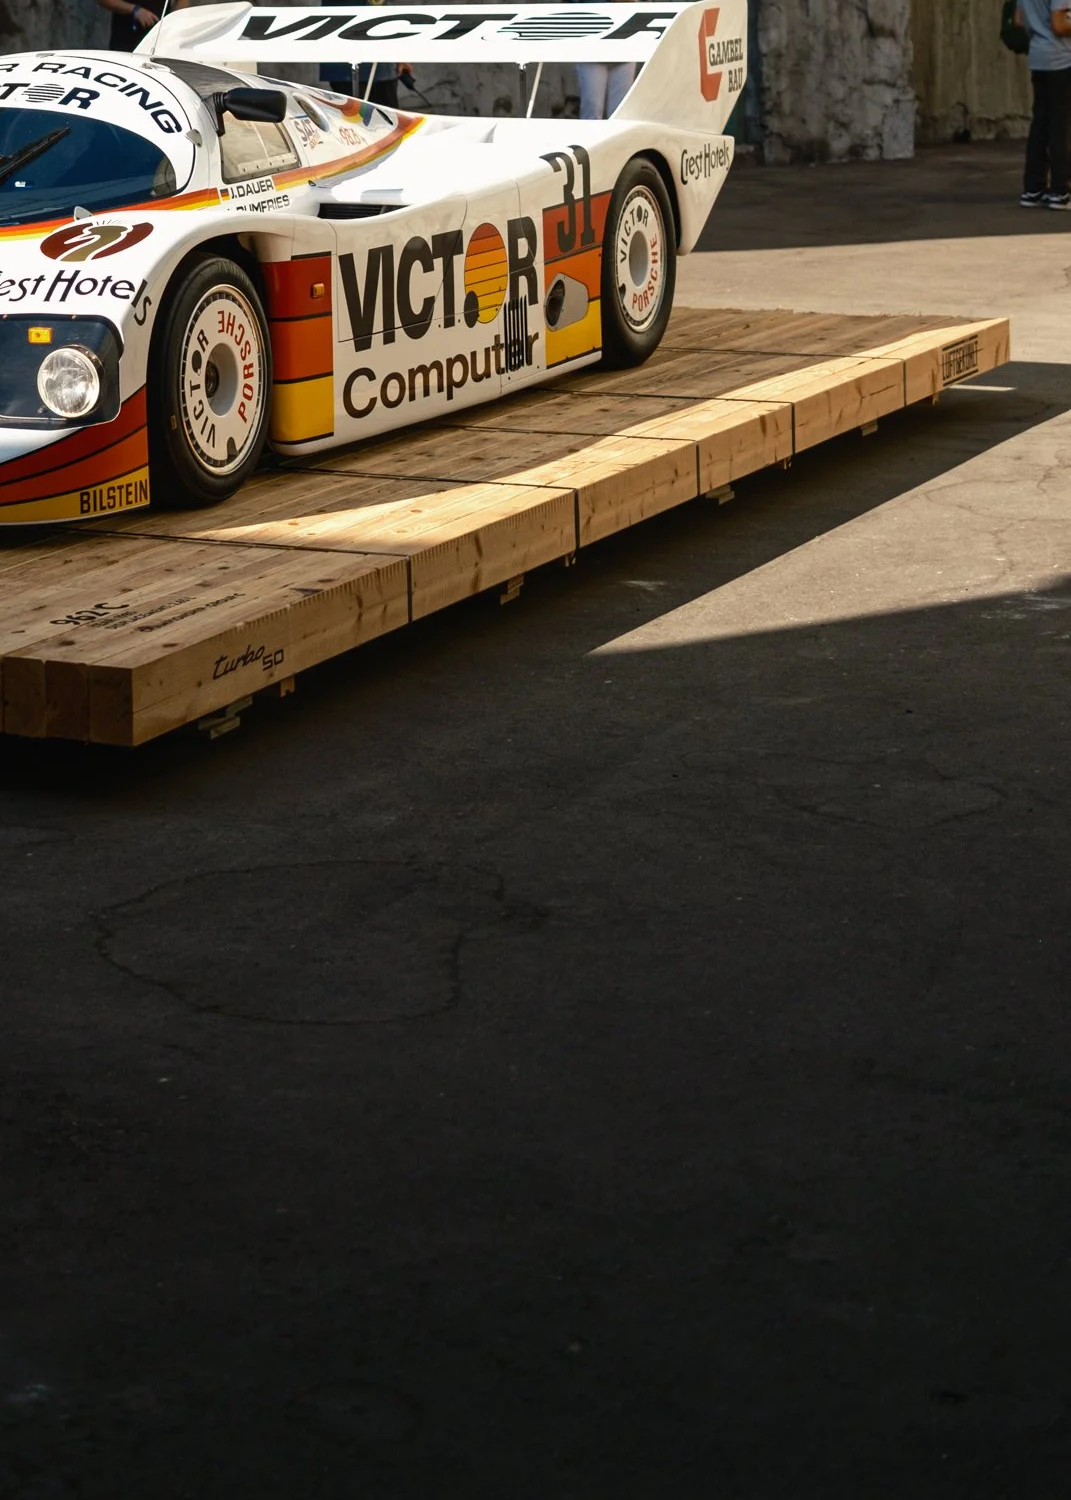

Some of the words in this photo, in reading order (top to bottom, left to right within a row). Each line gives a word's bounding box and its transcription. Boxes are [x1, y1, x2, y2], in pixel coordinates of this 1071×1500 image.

[708, 37, 744, 66] GAMBEL
[728, 67, 743, 92] BAU
[31, 62, 182, 134] RACING
[680, 149, 703, 185] Crest
[704, 140, 729, 179] Hotels
[539, 144, 595, 253] 31
[43, 269, 152, 326] Hotels
[338, 216, 539, 352] VICTOR
[631, 232, 658, 313] PORSCHE
[217, 310, 255, 424] PORSCHE
[342, 331, 539, 419] Computer
[79, 478, 148, 515] BILSTEIN
[213, 644, 266, 679] turbo
[262, 649, 284, 671] 50
